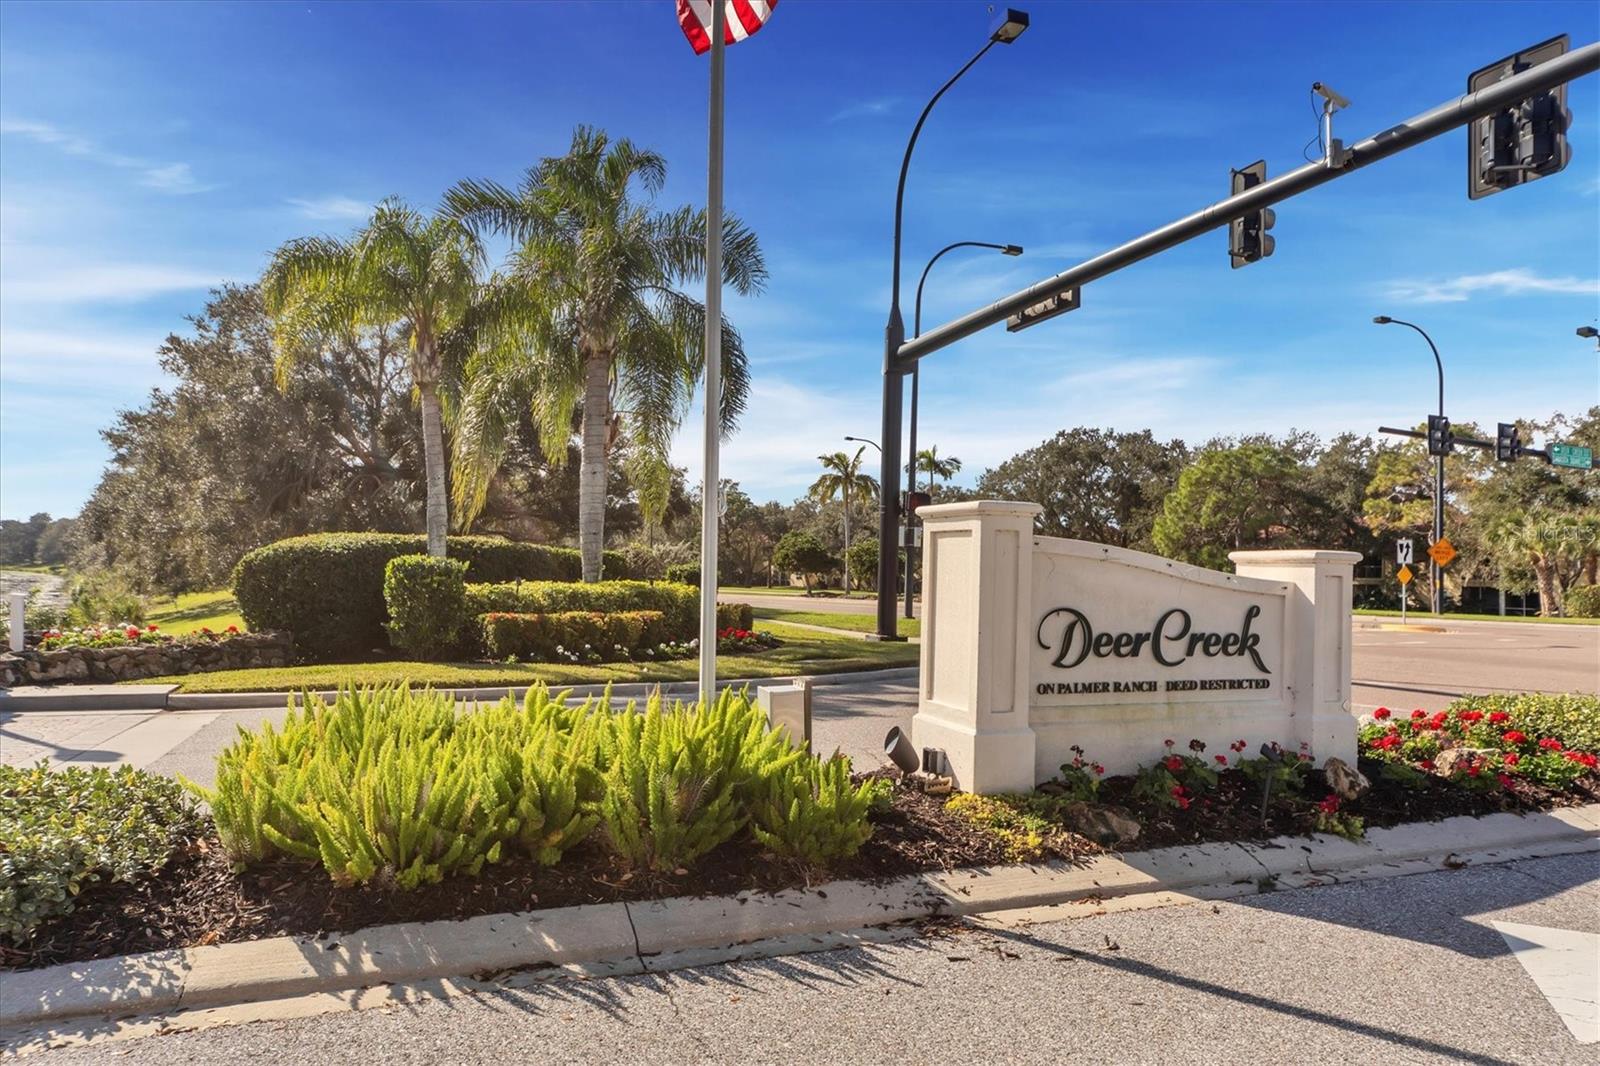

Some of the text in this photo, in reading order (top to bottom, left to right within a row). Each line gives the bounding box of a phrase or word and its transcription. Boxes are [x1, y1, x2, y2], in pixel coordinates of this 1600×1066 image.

[1036, 678, 1271, 695] ON PALMER RANCH DEED RESTRICTED
